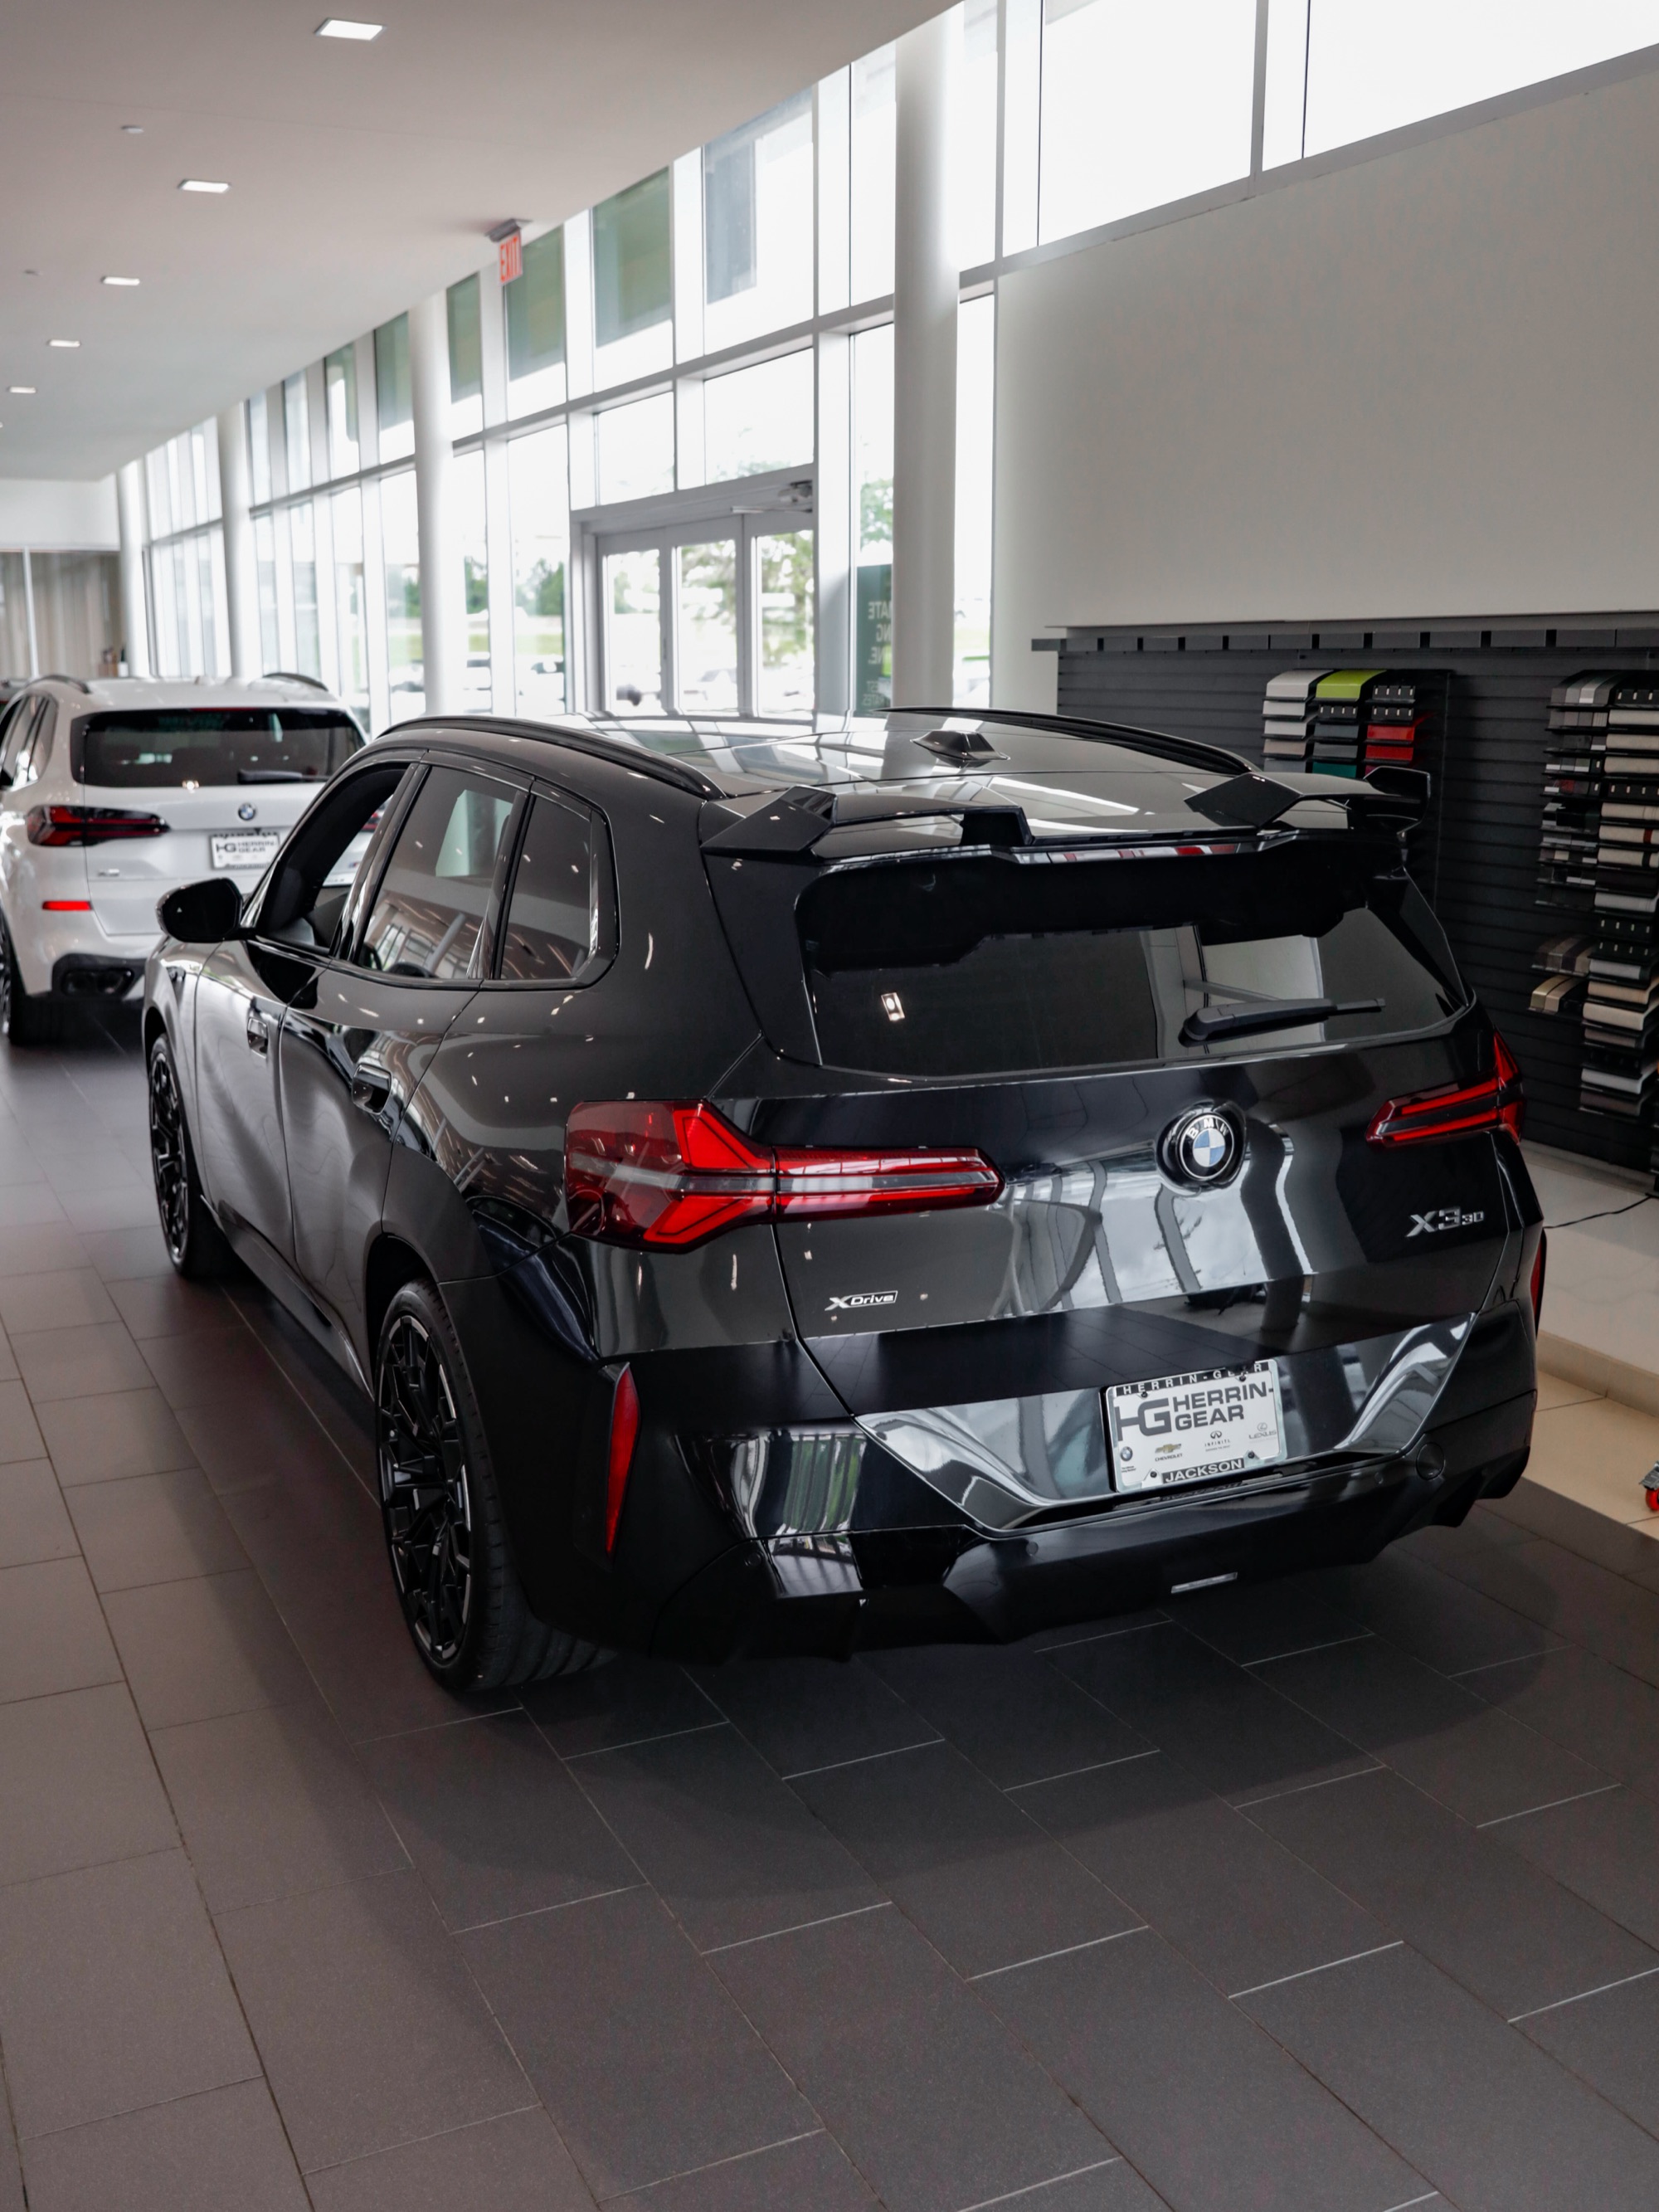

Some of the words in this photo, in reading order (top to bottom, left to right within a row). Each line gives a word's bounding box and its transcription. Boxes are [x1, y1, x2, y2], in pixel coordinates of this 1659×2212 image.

[499, 236, 519, 283] EXIT
[1186, 1118, 1228, 1139] BMW
[1175, 1404, 1244, 1430] GEAR
[1248, 1430, 1277, 1440] LEXUS
[1155, 1453, 1183, 1462] CHEVROLET
[1165, 1459, 1243, 1483] JACKSON
